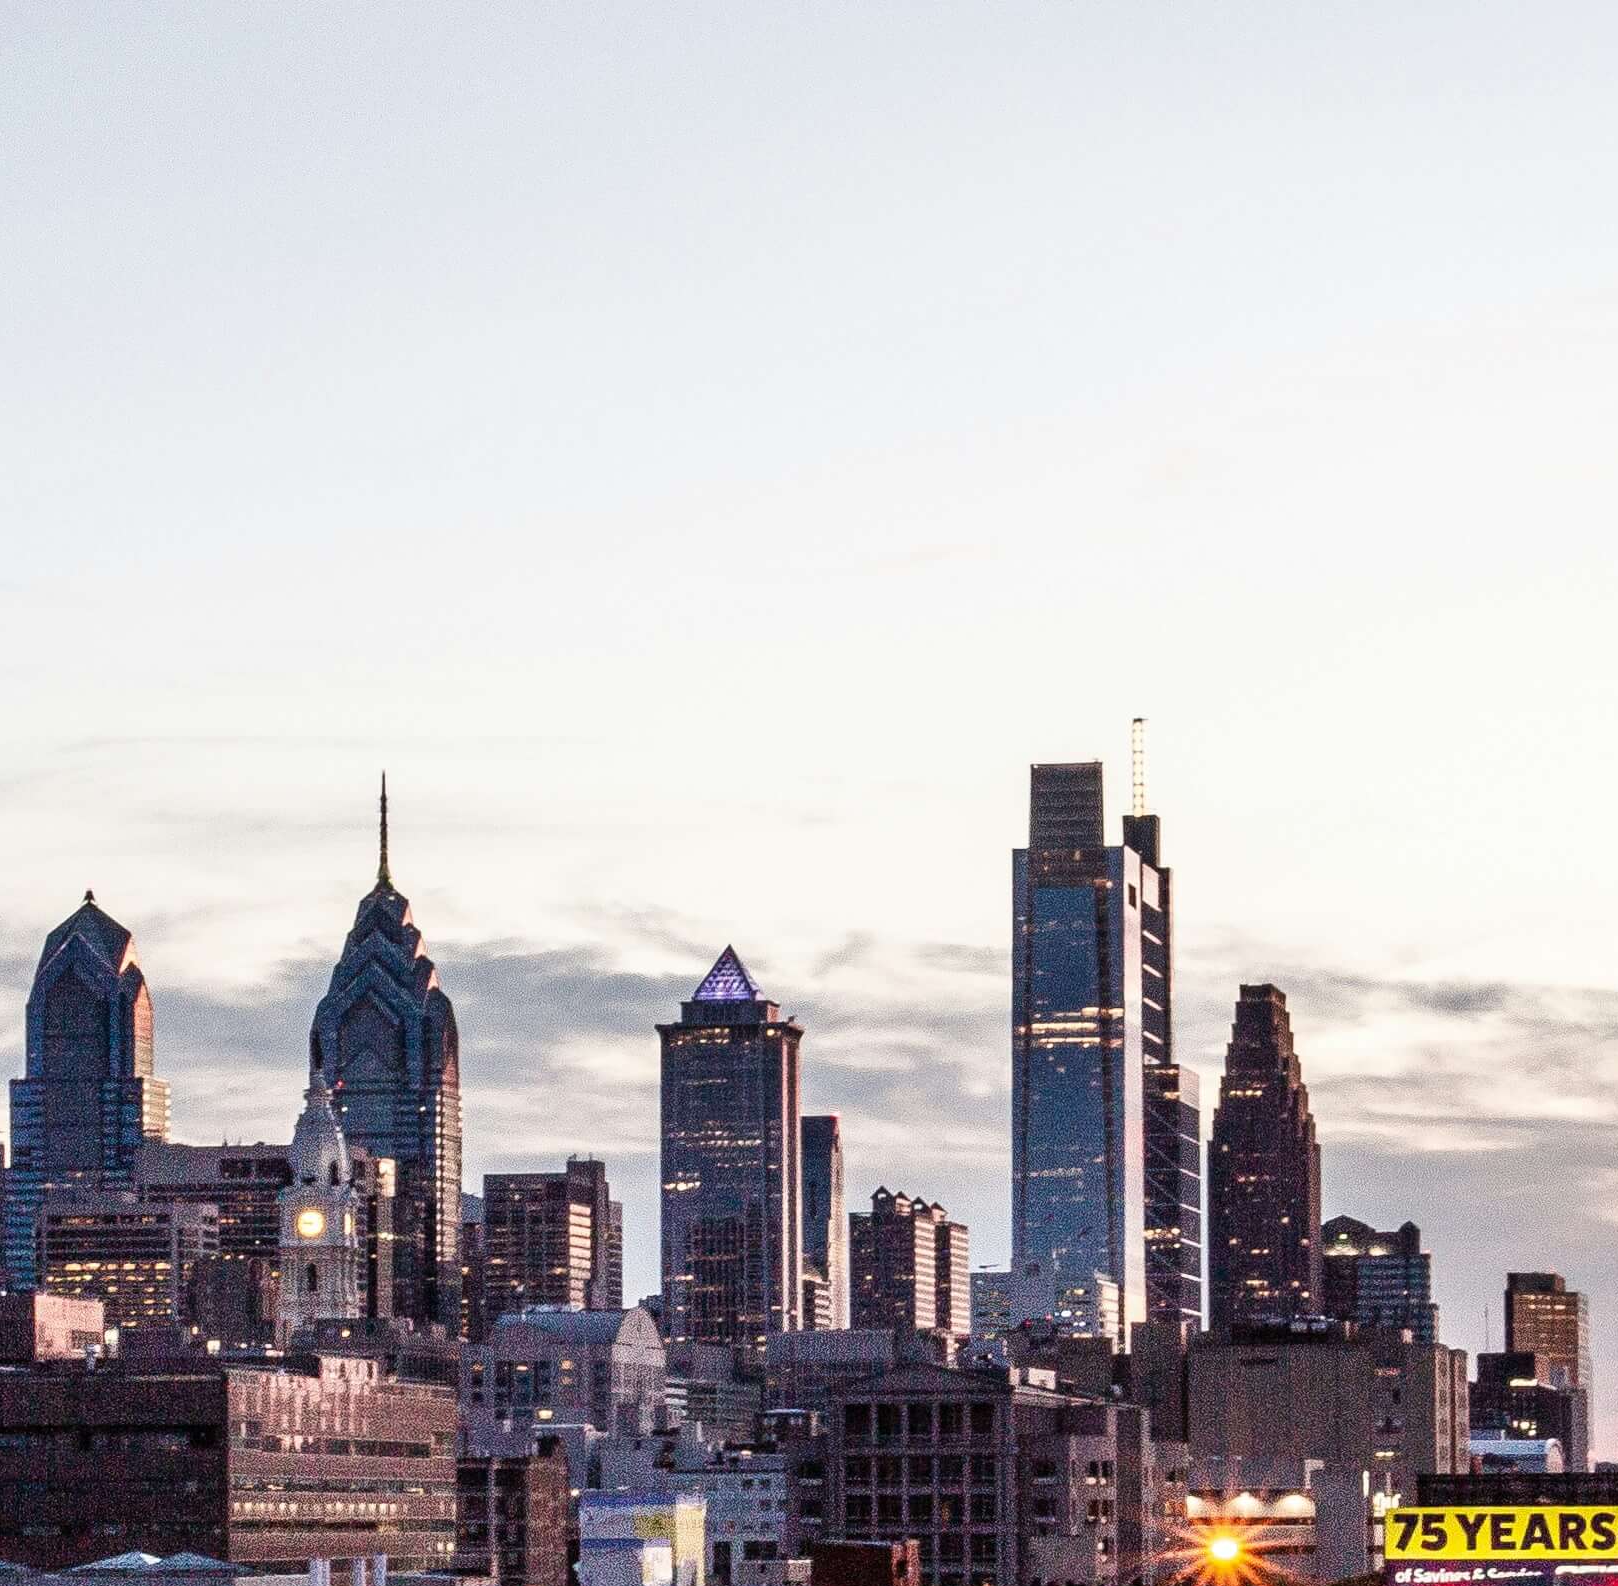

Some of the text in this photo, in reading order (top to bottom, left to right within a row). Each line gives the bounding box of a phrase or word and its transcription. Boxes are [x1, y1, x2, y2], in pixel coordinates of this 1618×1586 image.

[1393, 1512, 1616, 1552] 75 YEARS
[1394, 1567, 1412, 1583] of
